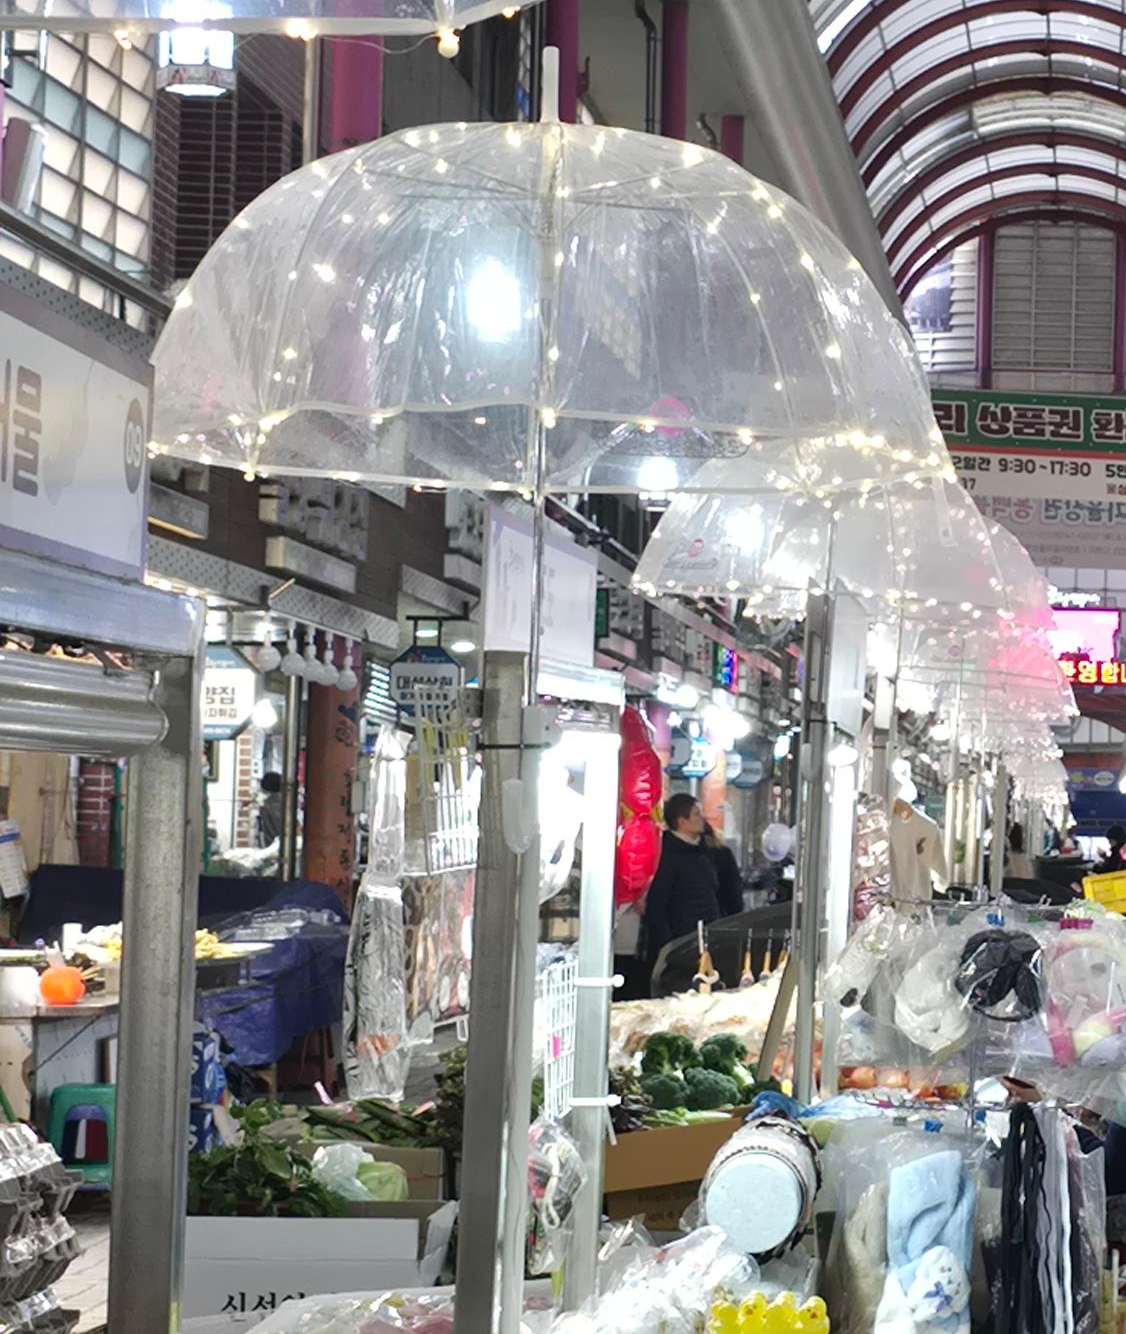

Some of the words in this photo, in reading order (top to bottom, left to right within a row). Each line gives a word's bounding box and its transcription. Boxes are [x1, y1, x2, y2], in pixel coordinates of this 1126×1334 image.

[0, 357, 42, 498] 물
[126, 421, 142, 468] 09
[932, 403, 968, 434] 리
[977, 403, 1084, 441] 상품권
